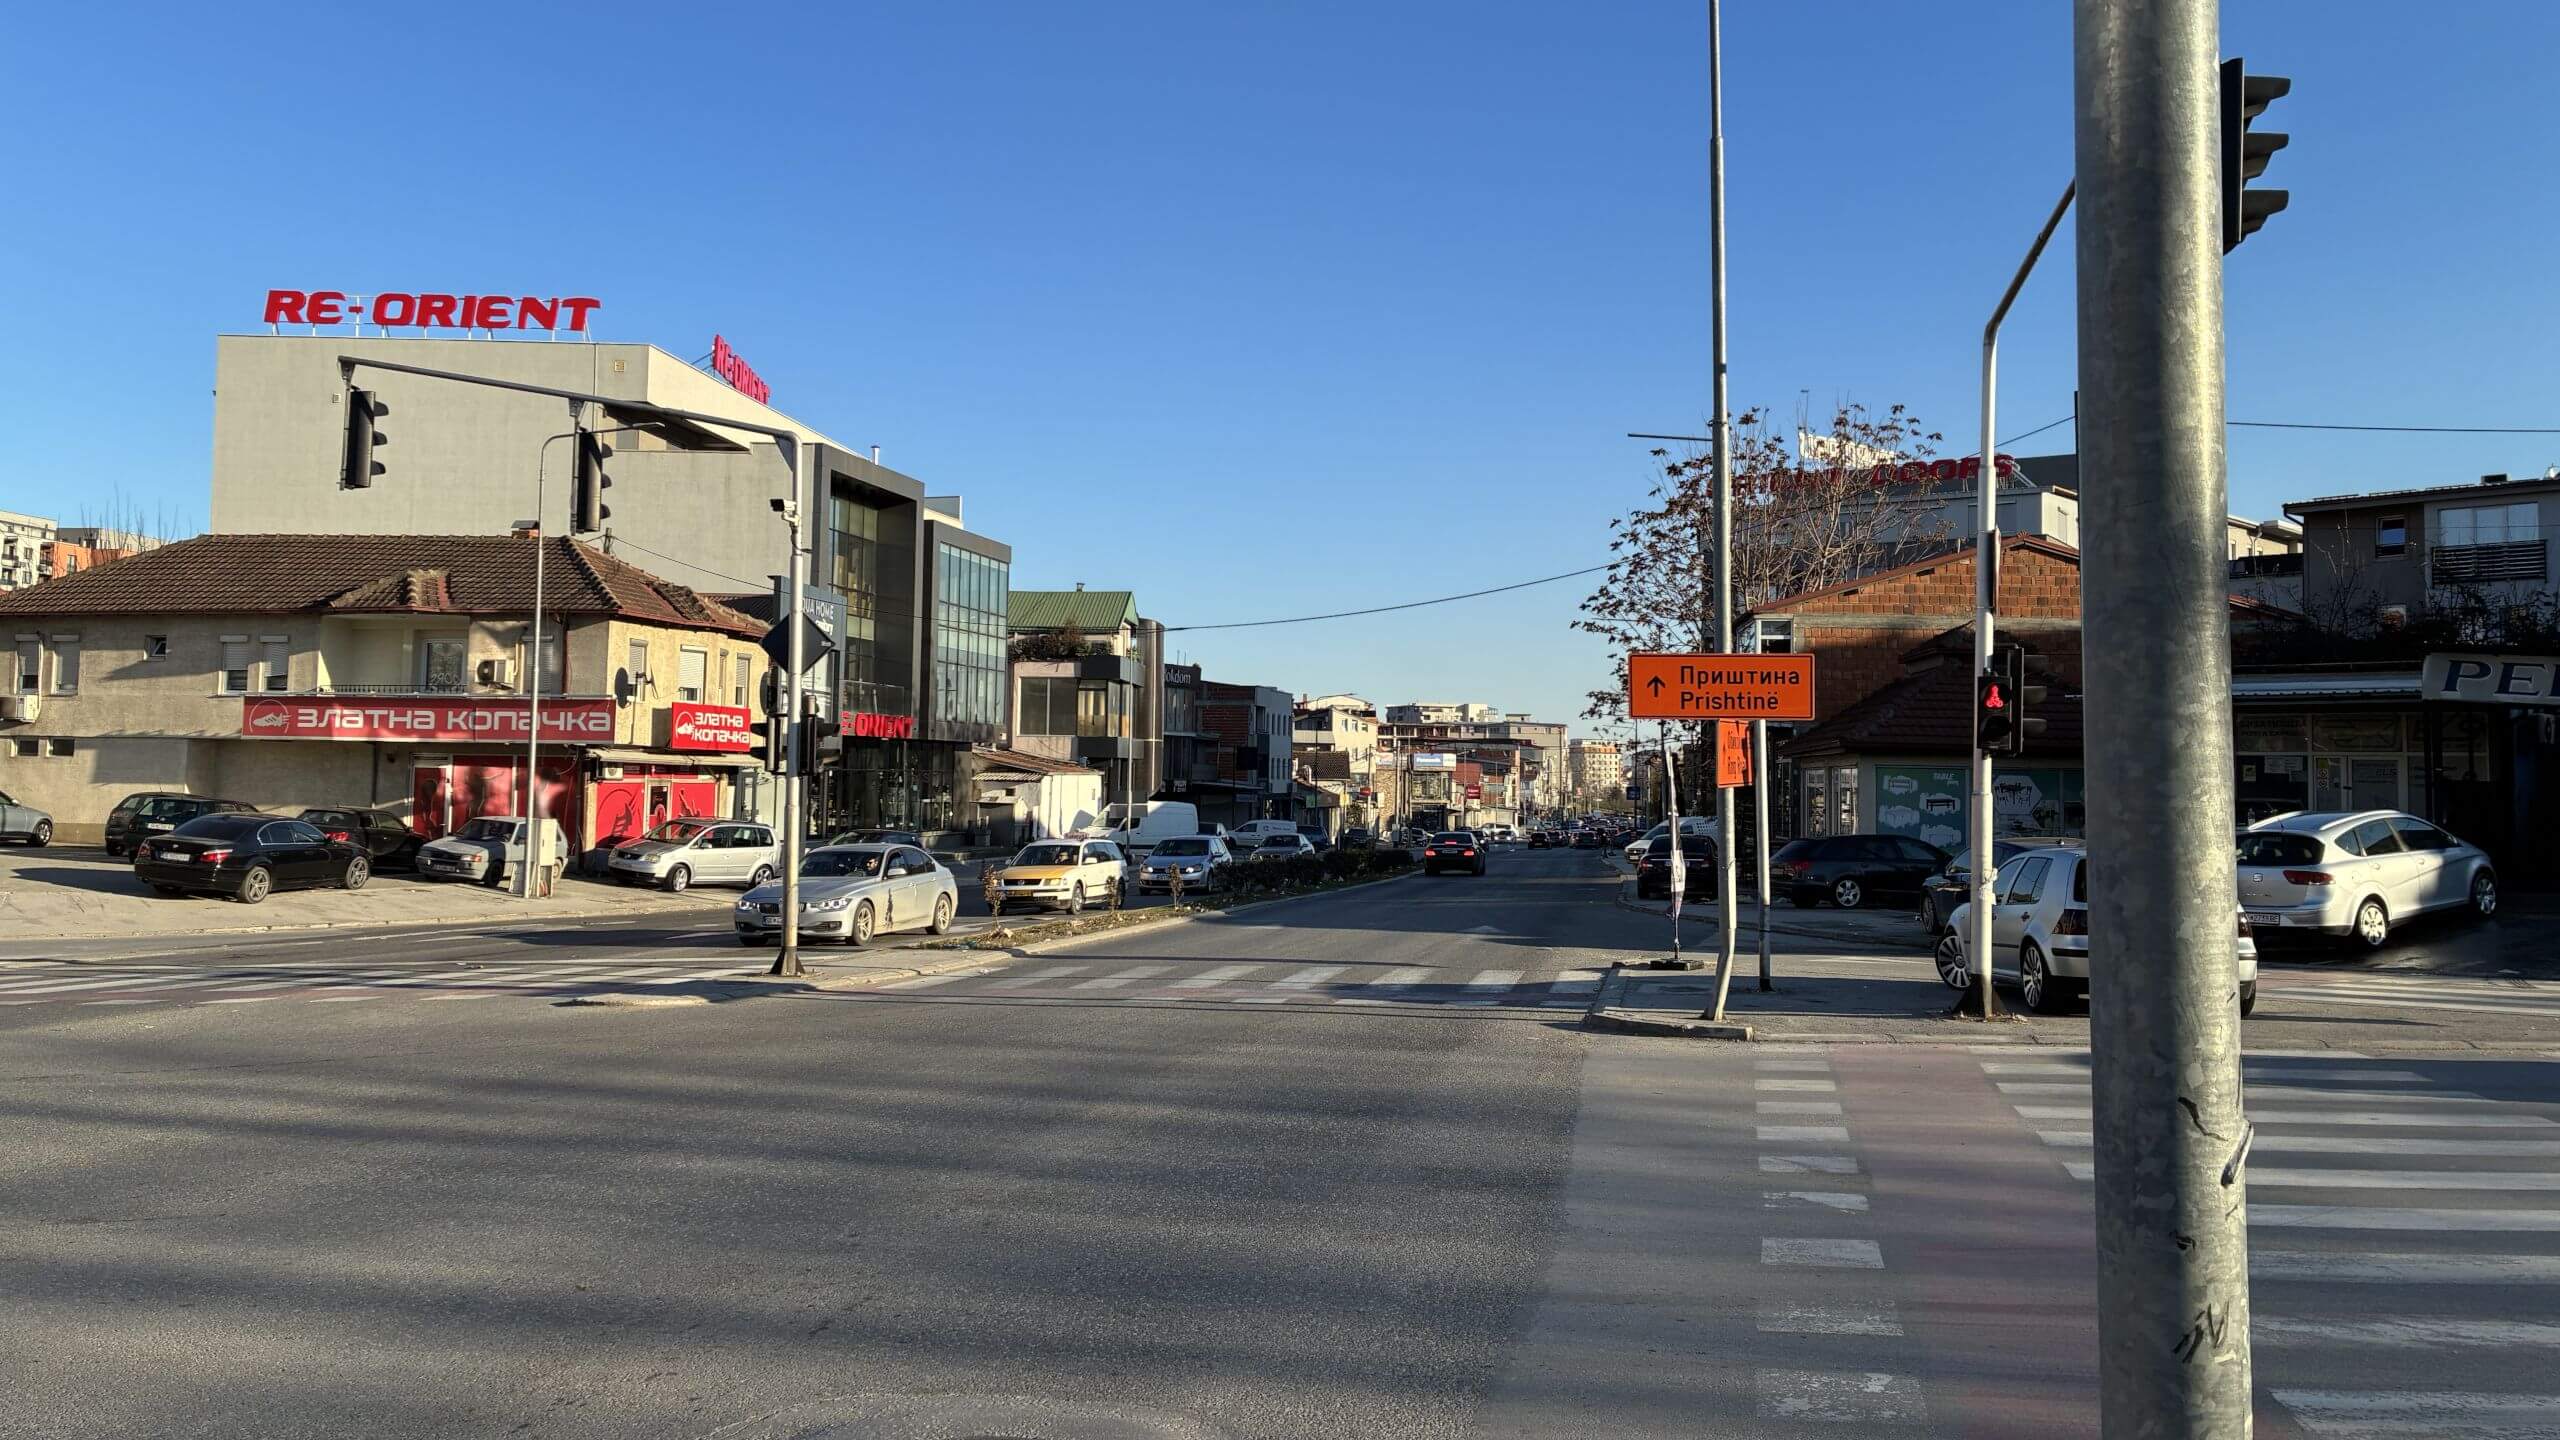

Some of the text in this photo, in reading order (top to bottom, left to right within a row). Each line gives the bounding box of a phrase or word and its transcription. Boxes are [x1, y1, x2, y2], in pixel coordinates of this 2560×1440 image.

[264, 290, 601, 331] RE-ORIENT
[1680, 666, 1800, 689] Приштина
[1680, 691, 1779, 710] Prishtinë
